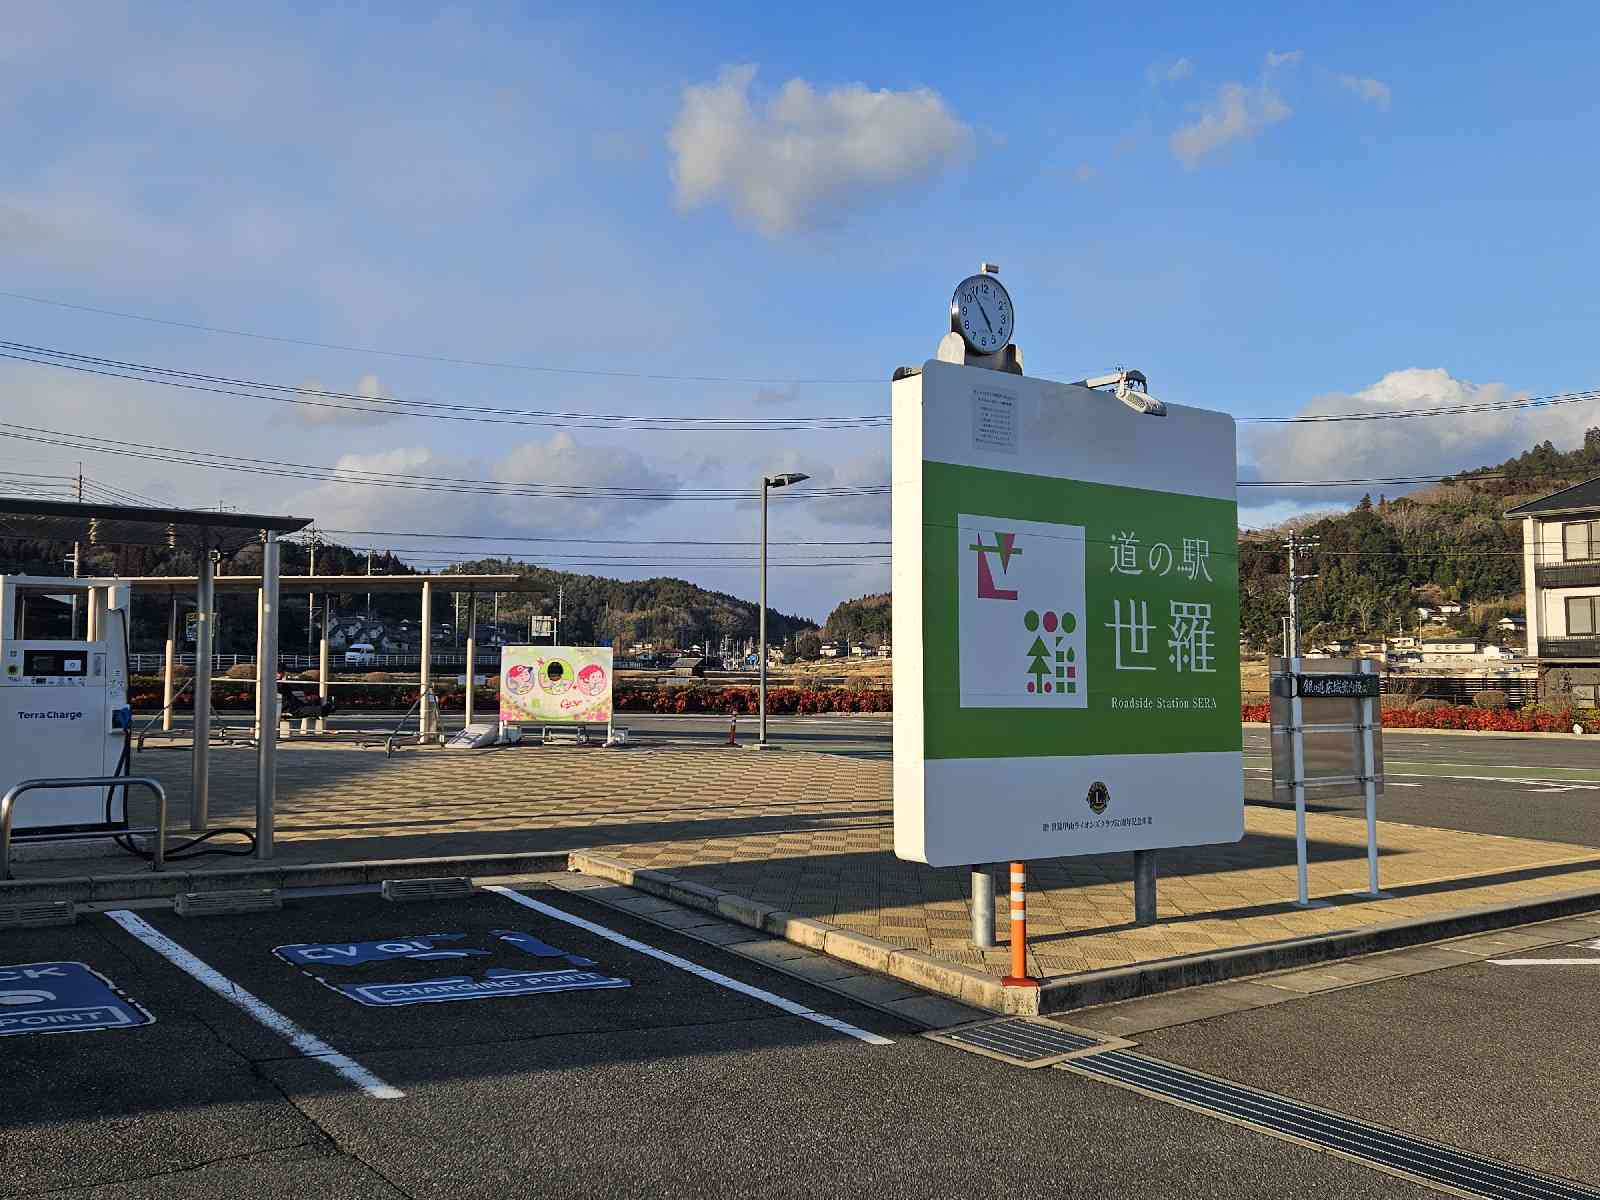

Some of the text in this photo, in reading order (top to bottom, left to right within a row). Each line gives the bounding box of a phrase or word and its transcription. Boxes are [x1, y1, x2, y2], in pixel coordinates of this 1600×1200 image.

[1109, 531, 1214, 583] 道の駅
[1104, 599, 1217, 673] 世羅
[1111, 697, 1217, 709] Roadside Station SERA
[382, 971, 599, 997] CHARGING POINT
